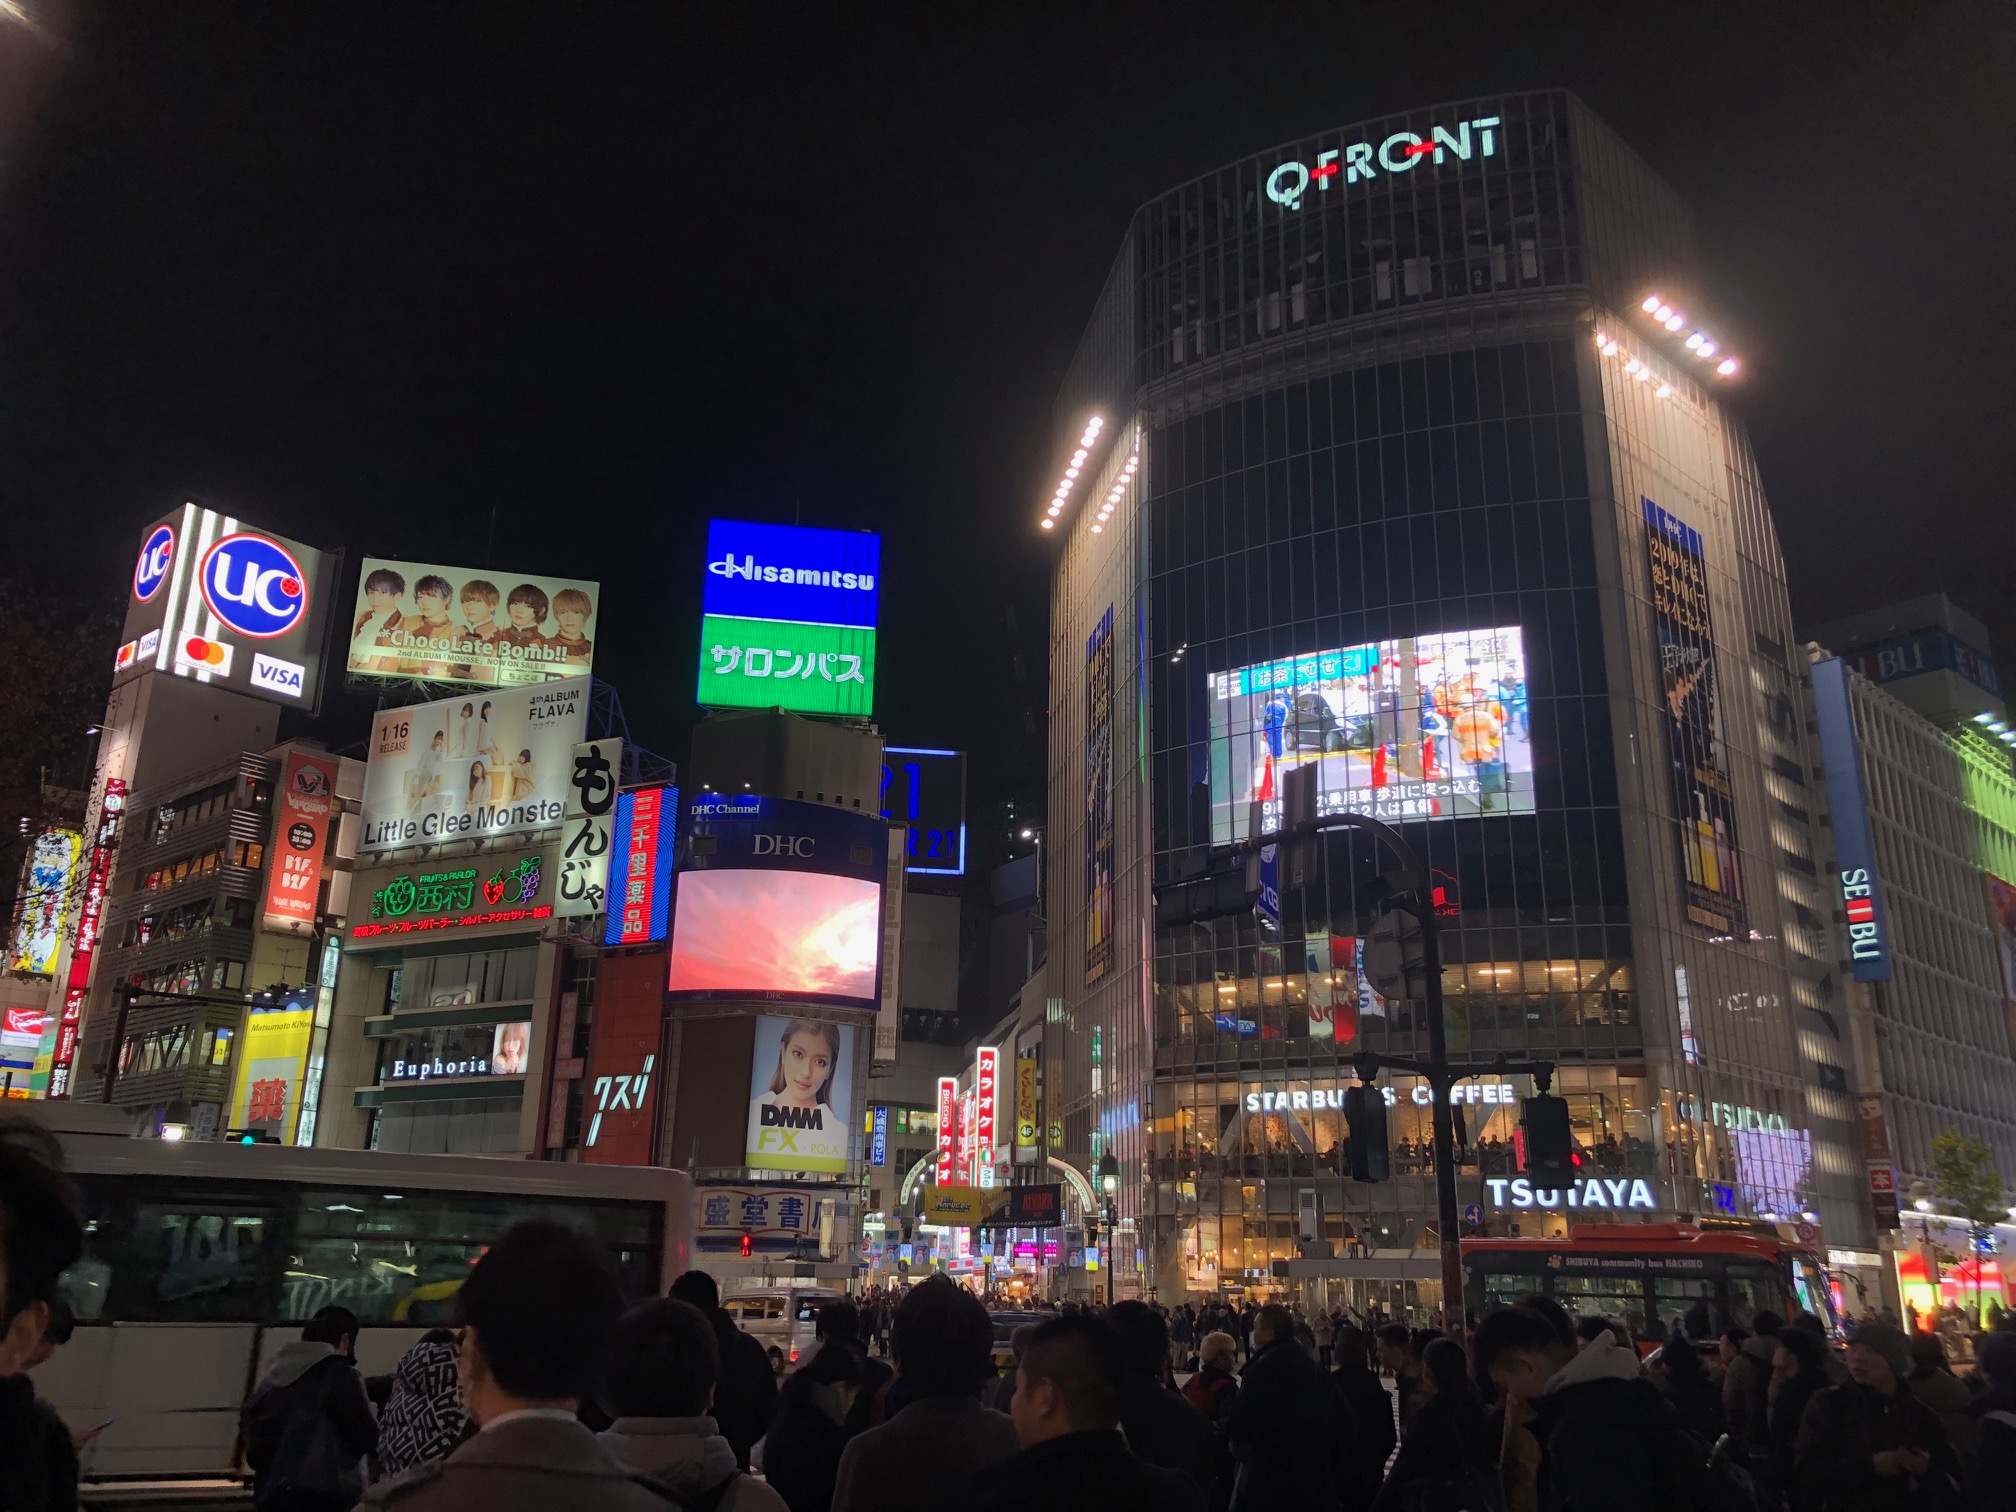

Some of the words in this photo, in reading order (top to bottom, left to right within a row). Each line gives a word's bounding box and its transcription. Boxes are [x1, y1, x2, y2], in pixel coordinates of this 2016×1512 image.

[1265, 116, 1500, 210] QFRONT
[138, 541, 170, 583] UC
[708, 553, 874, 591] Hisamitsu
[214, 551, 297, 617] UC
[141, 636, 157, 653] VISA
[396, 649, 413, 658] 2nd
[413, 651, 442, 661] ALBUM
[487, 658, 506, 668] NOW
[507, 660, 519, 668] ON
[498, 640, 568, 662] Bomb!!
[184, 659, 222, 675] mastercard
[257, 661, 301, 689] VISA
[710, 645, 865, 684] サロンパス
[529, 703, 575, 720] FLAVA
[381, 722, 409, 743] 1/16
[379, 740, 407, 754] RELEASE
[691, 804, 714, 816] DHC
[716, 803, 760, 815] Channel
[364, 817, 418, 845] Little
[422, 810, 472, 836] Glee
[560, 745, 617, 910] もんじゃ
[752, 834, 816, 858] DHC
[926, 829, 955, 858] 21
[285, 854, 312, 872] B1F
[622, 795, 655, 935] 三千里薬品
[281, 871, 310, 891] B2F
[372, 890, 384, 919] 渋谷
[416, 881, 475, 913] 西村
[1840, 868, 1881, 960] SEIBU
[766, 991, 784, 1000] DHC
[251, 1022, 290, 1033] Matsumoto
[393, 1055, 488, 1080] Euphoria
[248, 1077, 289, 1122] 薬
[978, 1058, 994, 1129] カラオケ
[1245, 1086, 1396, 1113] STARBUS
[1411, 1083, 1514, 1105] CFFEE
[761, 1103, 824, 1131] DMM
[1021, 1125, 1033, 1137] 4F
[757, 1127, 800, 1153] FX
[810, 1142, 839, 1155] ROLA
[873, 1108, 886, 1165] 大盛堂商事ビル
[1486, 1178, 1654, 1207] TSUTAYA
[1565, 1257, 1599, 1267] SHIBUYA
[1601, 1258, 1645, 1270] community
[1647, 1258, 1663, 1268] bus
